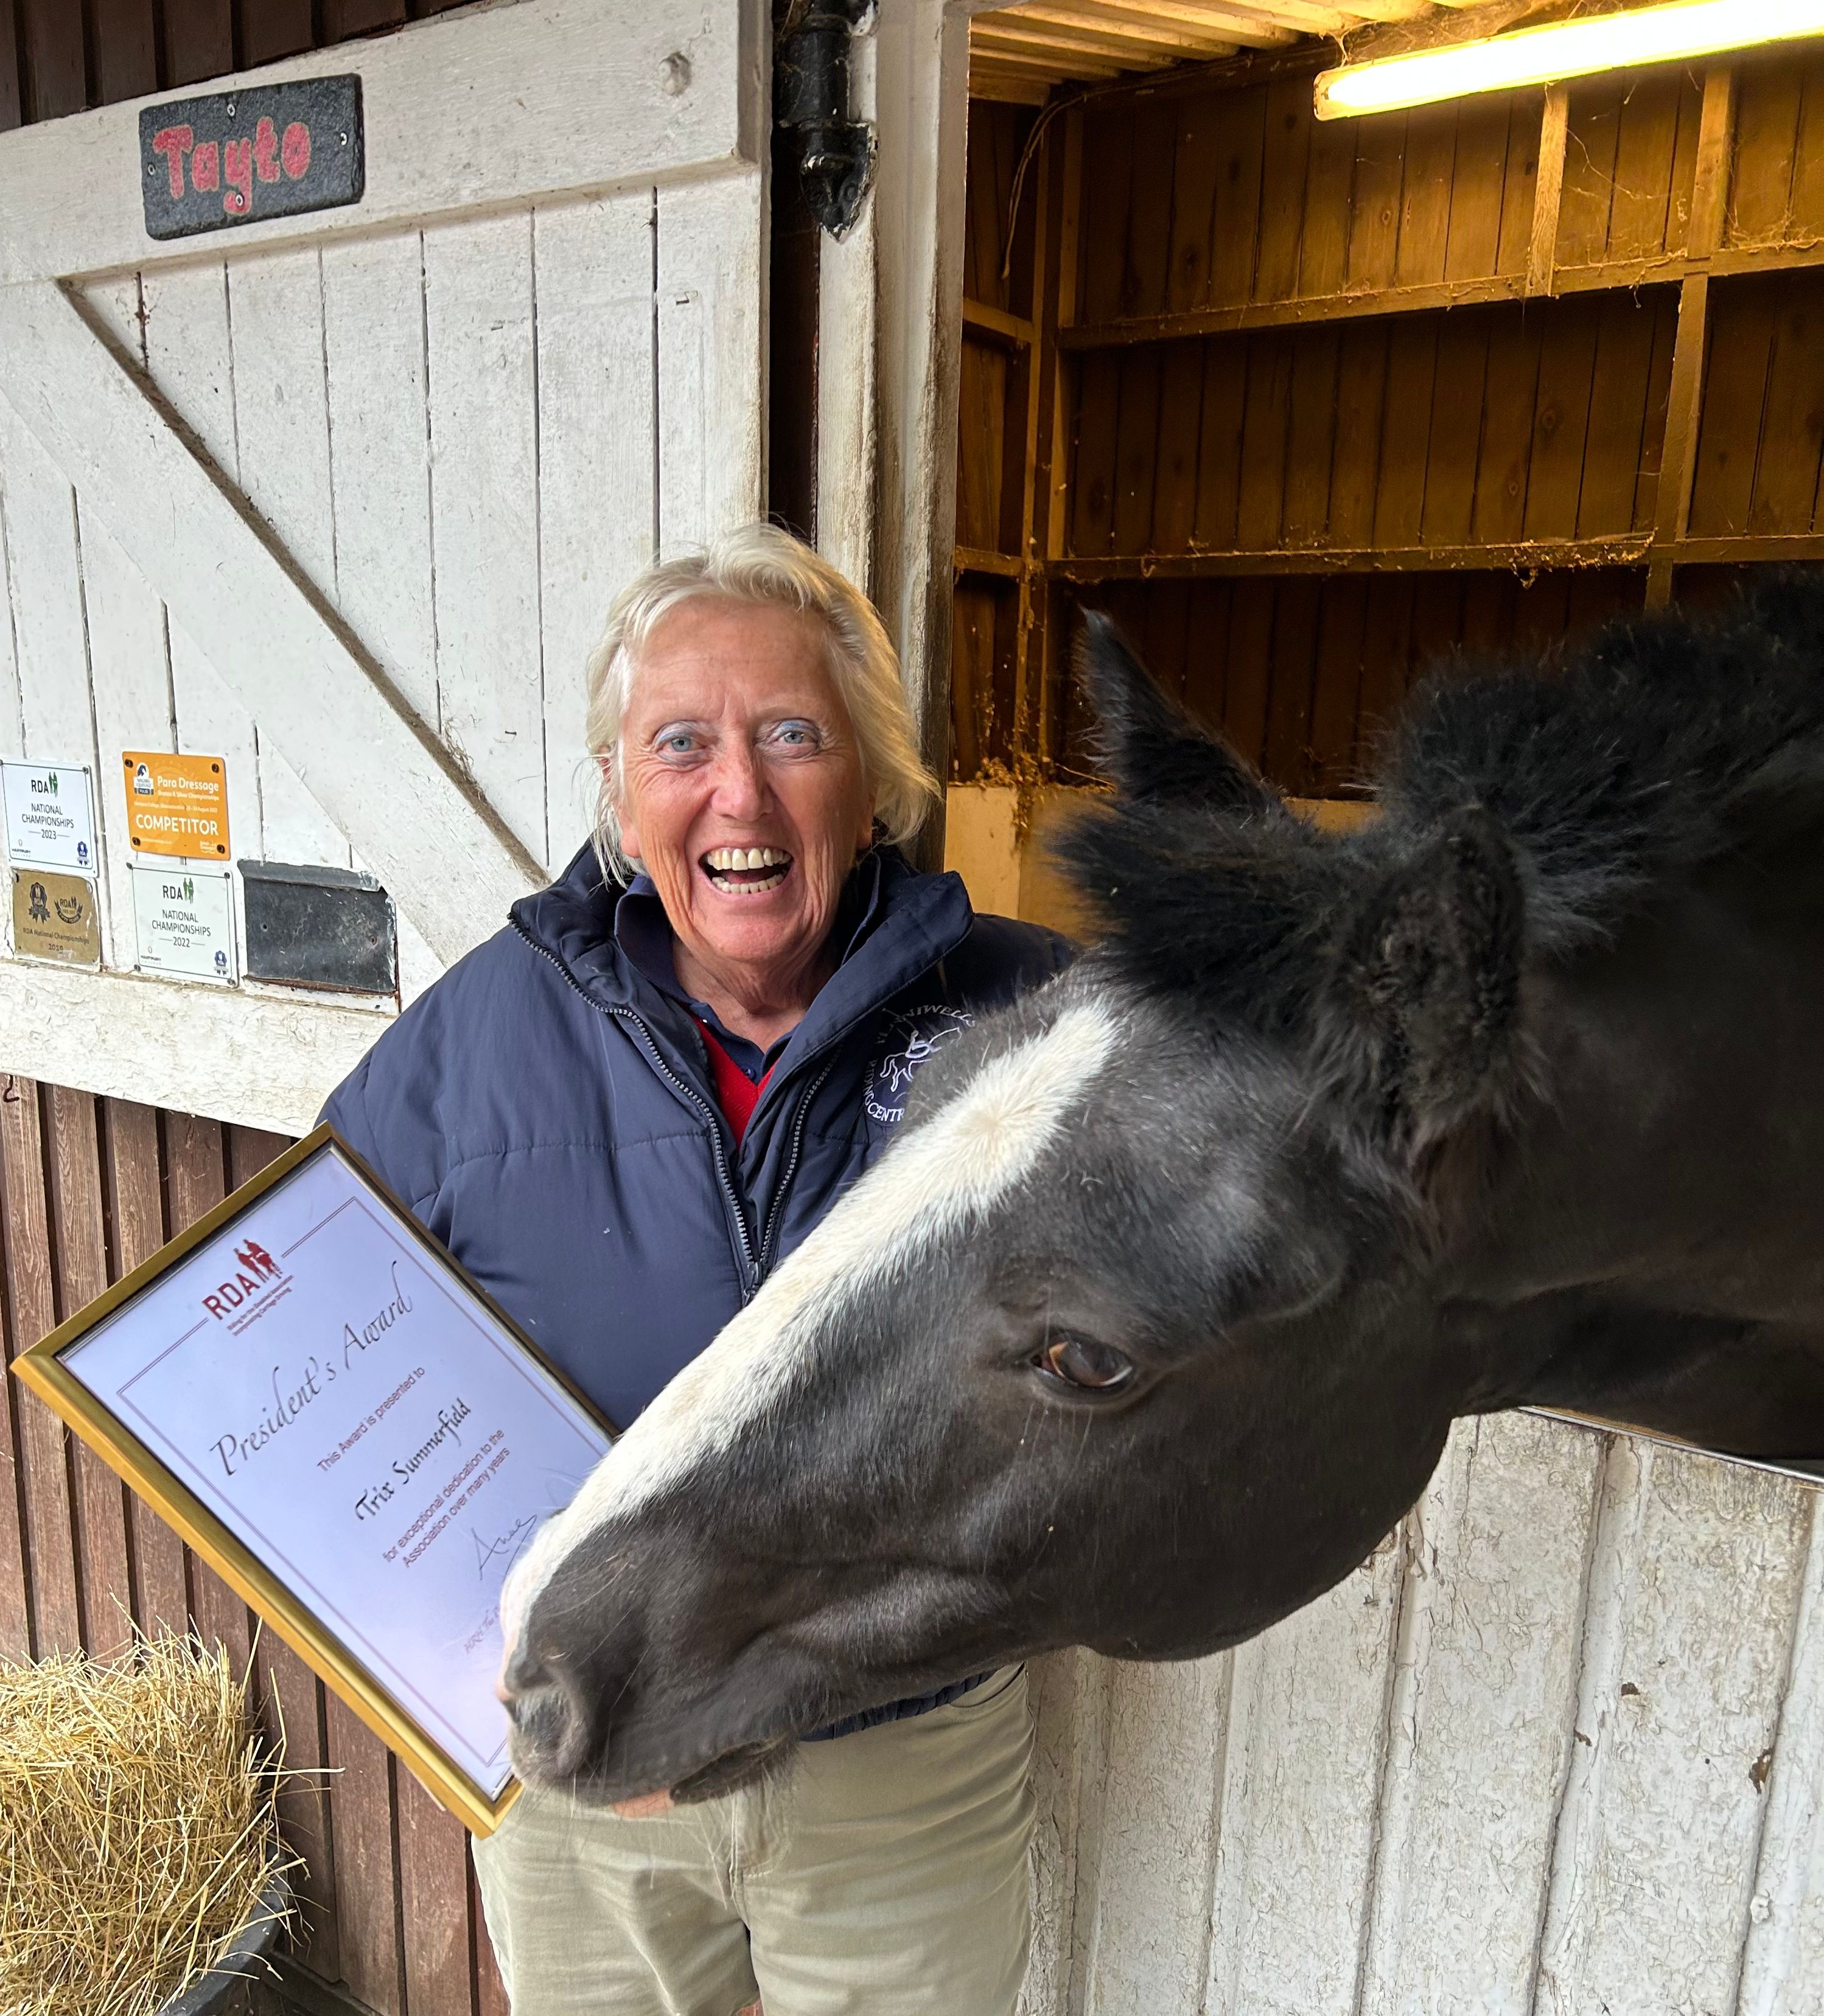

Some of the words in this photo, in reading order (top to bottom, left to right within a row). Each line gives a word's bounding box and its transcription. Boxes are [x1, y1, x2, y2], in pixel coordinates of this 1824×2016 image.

[152, 116, 312, 215] Tayto
[31, 780, 49, 794] RDA
[157, 775, 177, 788] Para
[178, 776, 219, 794] Dressage
[31, 803, 63, 815] NATIONAL
[22, 814, 74, 829] CHAMPIONSHIPS
[136, 814, 219, 836] COMPETITOR
[41, 829, 57, 840] 2023
[162, 885, 183, 901] RDA
[60, 898, 72, 908] RDA
[162, 909, 198, 923] NATIONAL
[152, 919, 211, 937] CHAMPIONSHIPS
[34, 930, 54, 938] National
[54, 932, 89, 945] Championships
[173, 936, 190, 948] 2022
[867, 1102, 905, 1122] CENTR
[201, 1272, 261, 1320] RDA
[209, 1356, 337, 1476] President's
[343, 1260, 413, 1370] Award
[316, 1452, 341, 1471] This
[338, 1422, 368, 1454] Award
[363, 1414, 377, 1426] is
[375, 1375, 416, 1420] presented
[413, 1367, 425, 1379] to
[355, 1481, 395, 1521] Trix
[393, 1397, 471, 1485] Summerfield
[383, 1546, 399, 1563] for
[398, 1494, 446, 1548] exceptional
[442, 1453, 484, 1498] dedication
[480, 1443, 492, 1455] to
[489, 1429, 505, 1446] the
[403, 1514, 452, 1568] Association
[449, 1494, 468, 1516] over
[466, 1470, 491, 1496] many
[487, 1447, 511, 1475] years
